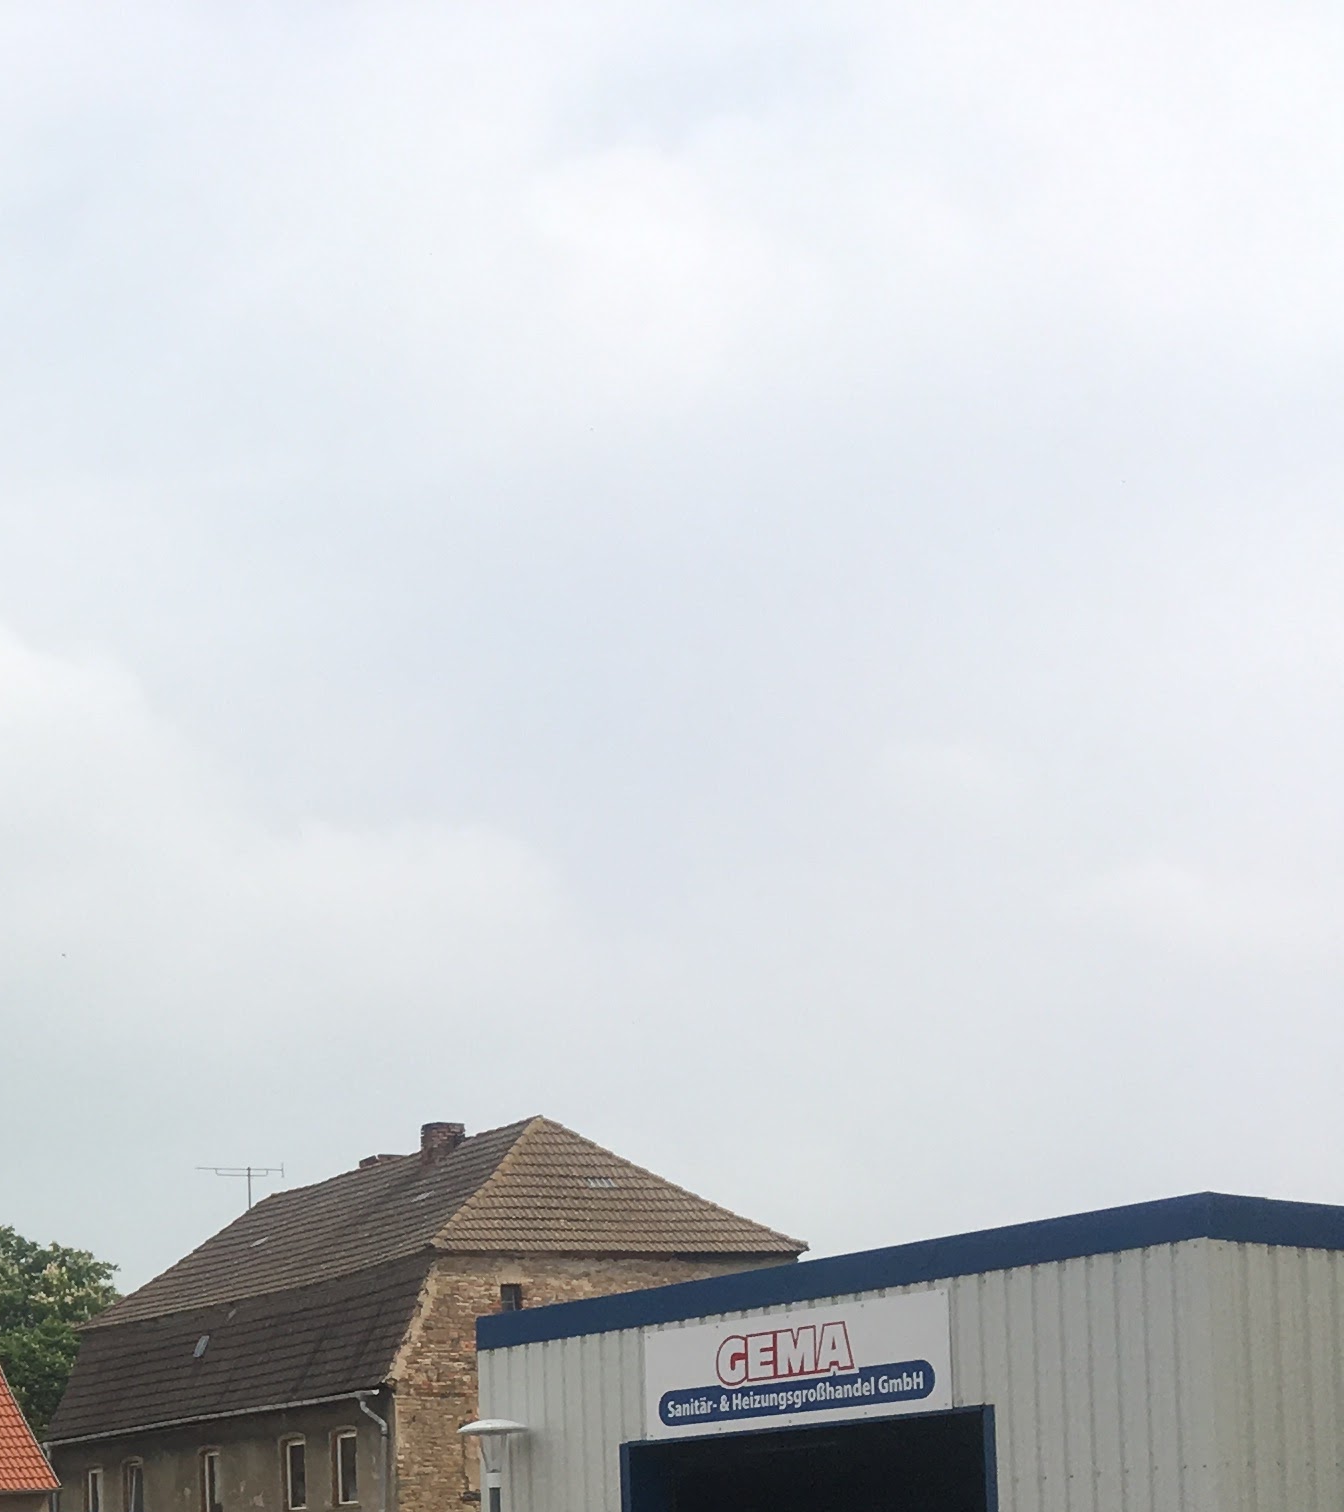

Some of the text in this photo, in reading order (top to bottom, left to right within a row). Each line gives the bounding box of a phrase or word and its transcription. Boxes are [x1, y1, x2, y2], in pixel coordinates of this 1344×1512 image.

[715, 1320, 855, 1387] GEMA
[667, 1370, 925, 1418] Sanitär- & Heizungsgroßhandel GmbH
